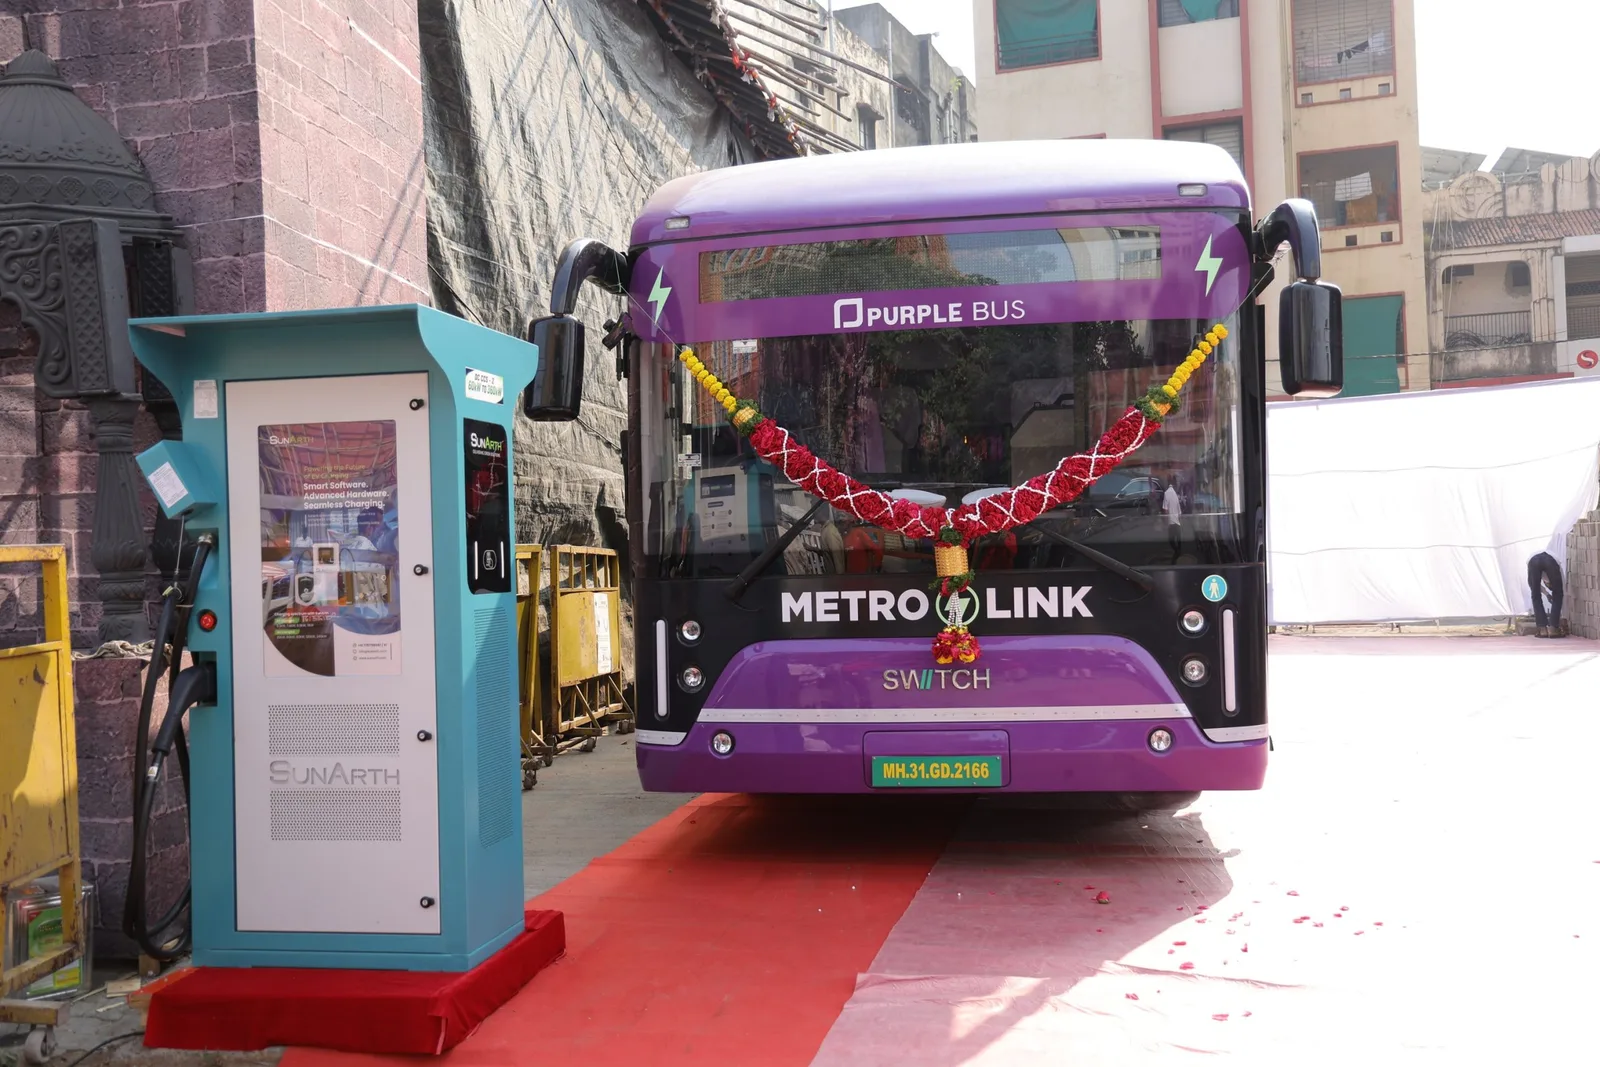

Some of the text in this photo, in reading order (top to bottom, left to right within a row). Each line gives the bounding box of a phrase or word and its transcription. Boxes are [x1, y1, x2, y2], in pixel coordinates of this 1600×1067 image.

[867, 300, 1026, 327] PURPLE BUS
[303, 480, 369, 491] Smart Software.
[303, 489, 390, 500] Advanced Hardware.
[303, 499, 386, 510] Seamless Charging.
[781, 585, 1094, 622] METRO LINK
[883, 762, 989, 779] MH.31.GD.2166
